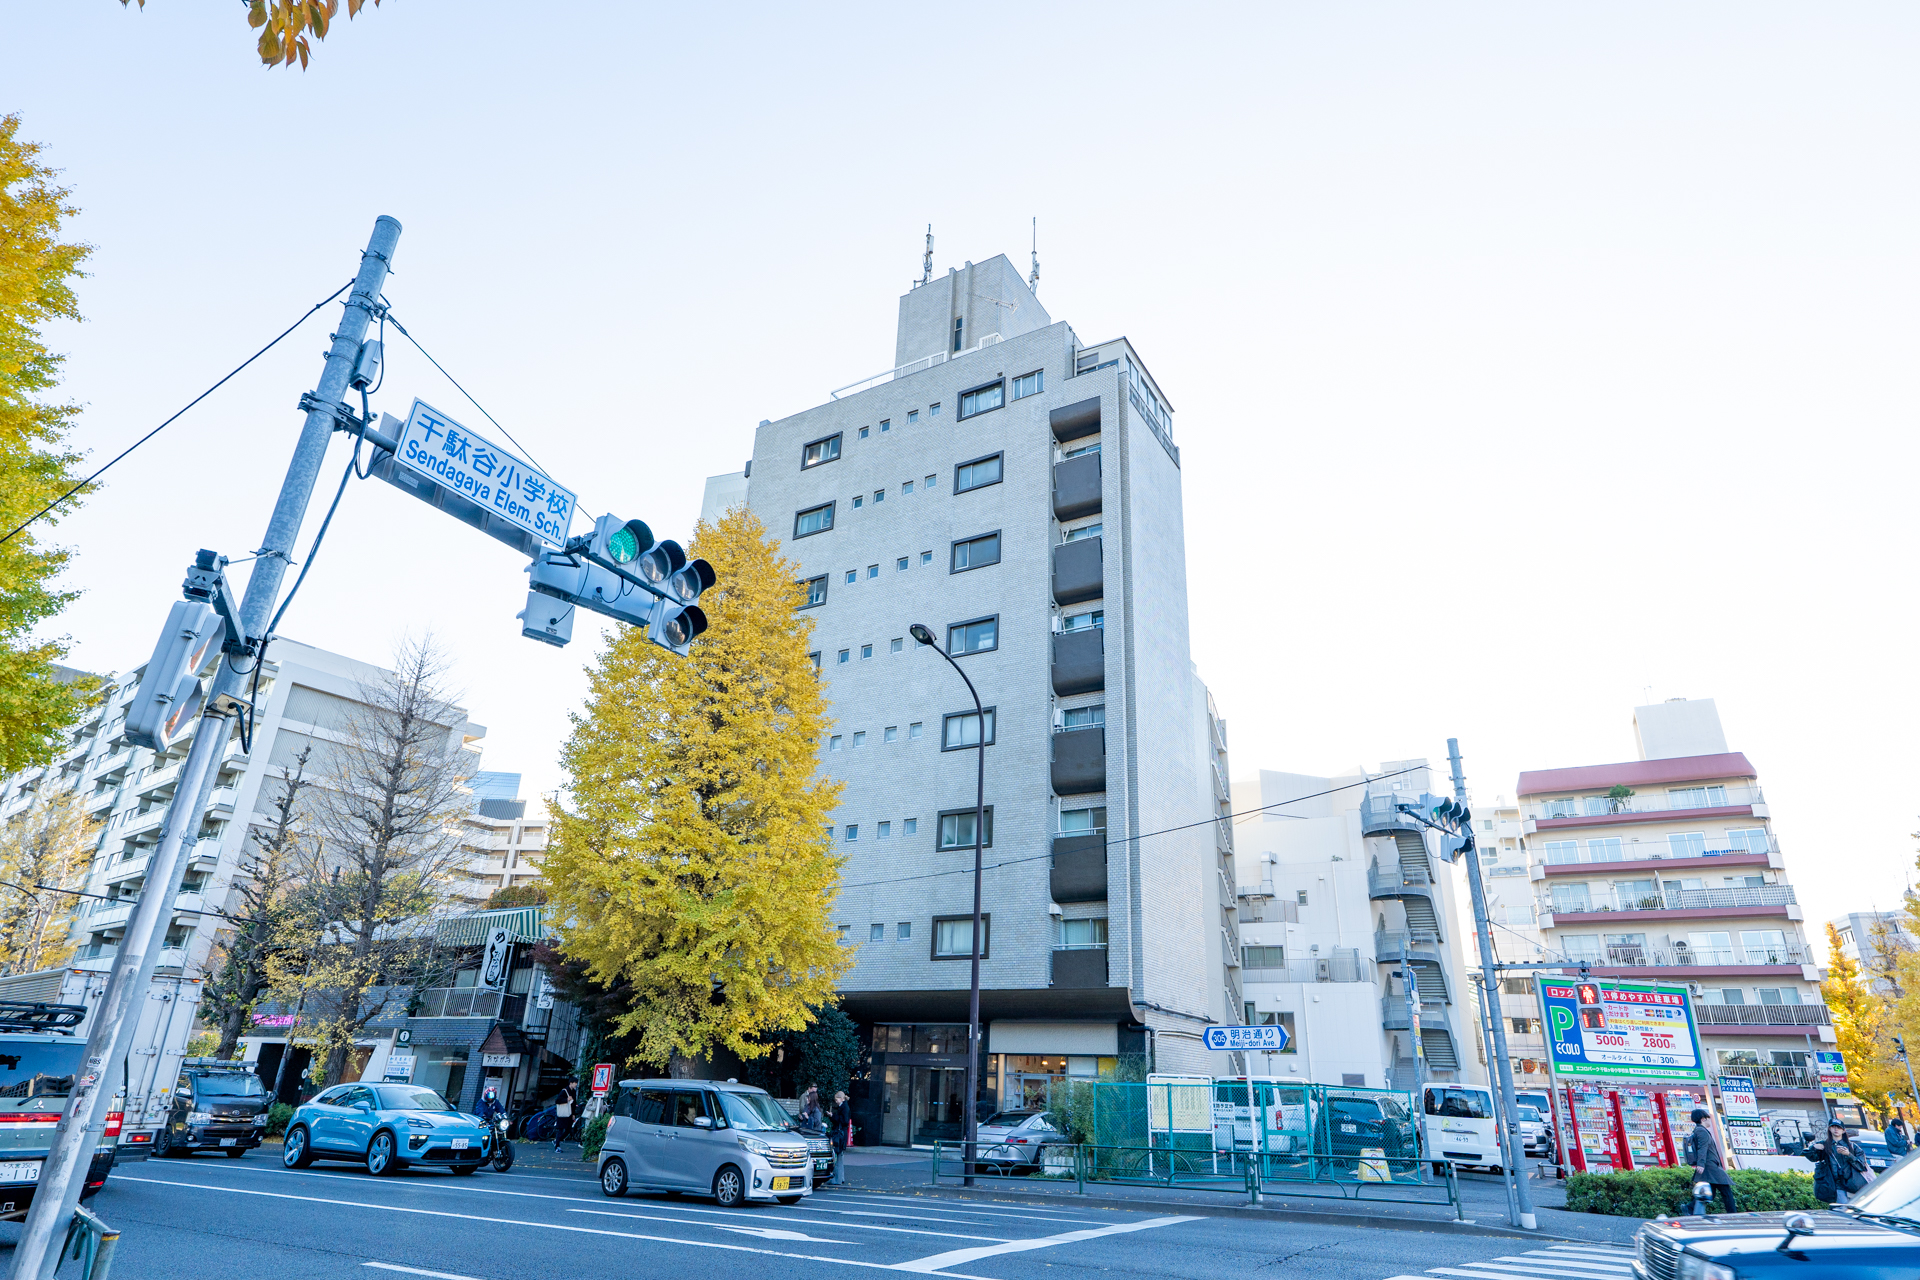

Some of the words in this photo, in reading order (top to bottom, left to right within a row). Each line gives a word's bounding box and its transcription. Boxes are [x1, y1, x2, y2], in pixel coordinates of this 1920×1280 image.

[417, 413, 569, 520] 千駄谷小学校
[406, 439, 491, 500] Sendagaya
[493, 488, 532, 524] Elem.
[534, 511, 562, 540] Sch.
[1212, 1034, 1226, 1043] 305
[1230, 1028, 1274, 1040] 明治通り
[1549, 1005, 1575, 1042] P
[1230, 1039, 1261, 1048] Meiji-dori
[1262, 1039, 1277, 1047] Ave.
